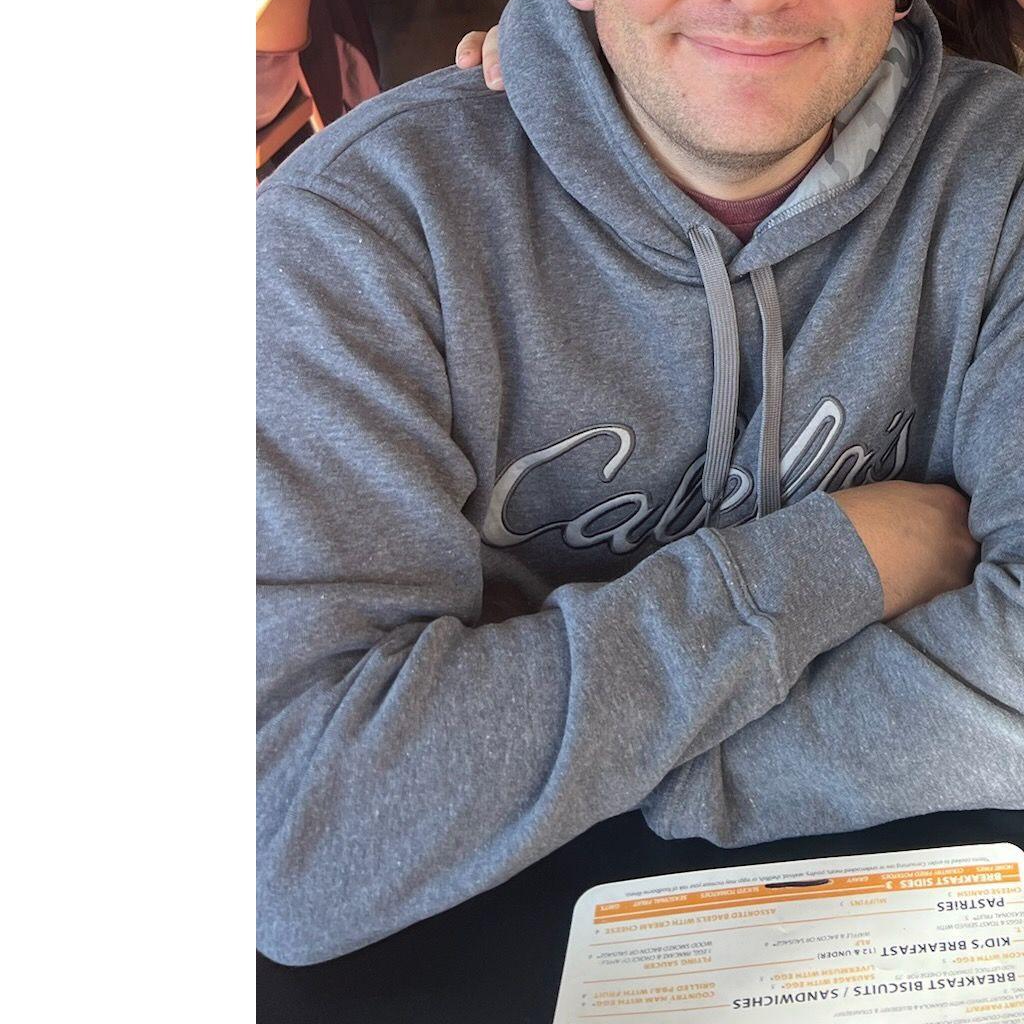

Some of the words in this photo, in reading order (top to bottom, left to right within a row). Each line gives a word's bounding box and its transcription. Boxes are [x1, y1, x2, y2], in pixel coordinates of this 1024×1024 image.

[899, 877, 933, 888] SIDES
[936, 871, 1002, 885] BREAKFAST
[695, 913, 727, 923] BAGELS
[729, 907, 775, 919] ASSORTED
[638, 920, 670, 929] CREAM
[671, 917, 693, 925] WITH
[604, 924, 638, 933] CHEESE
[970, 935, 1010, 949] KID'S
[862, 946, 876, 954] (12
[880, 939, 967, 957] BREAKFAST
[816, 949, 851, 959] UNDER)
[977, 952, 1000, 960] WITH
[795, 970, 818, 978] WITH
[820, 964, 873, 975] LIVERMUSH
[806, 977, 831, 986] WITH
[833, 973, 874, 983] SAUSAGE
[927, 971, 1016, 990] BREAKFAST
[675, 981, 715, 990] GRILLED
[852, 980, 923, 997] BISCUITS
[621, 987, 648, 995] WITH
[670, 990, 714, 1000] COUNTRY
[617, 996, 642, 1005] WITH
[732, 989, 838, 1009] SANDWICHES
